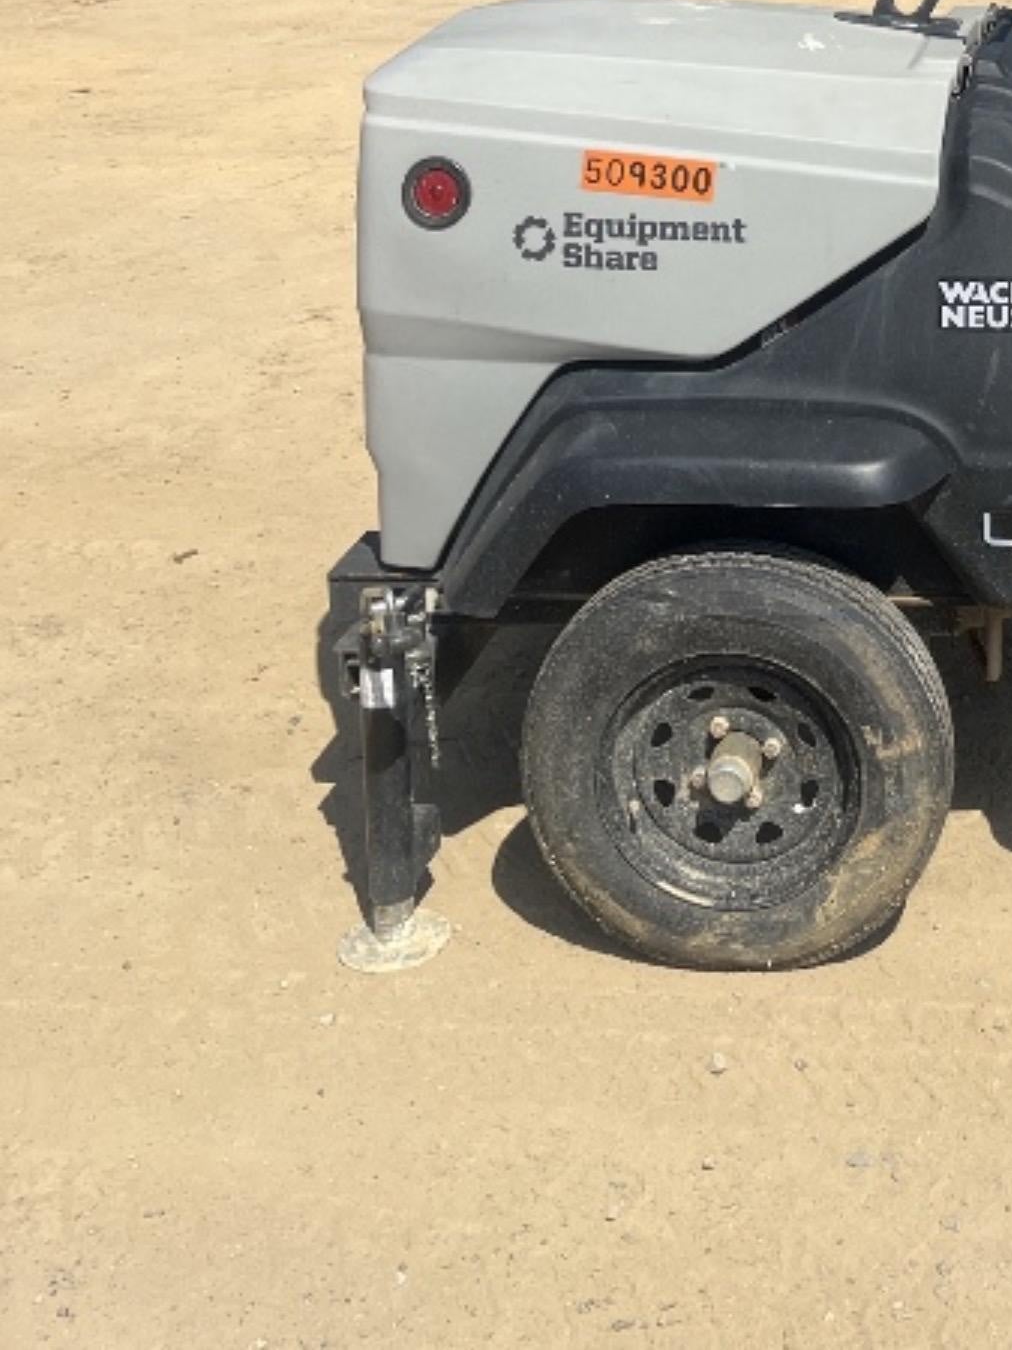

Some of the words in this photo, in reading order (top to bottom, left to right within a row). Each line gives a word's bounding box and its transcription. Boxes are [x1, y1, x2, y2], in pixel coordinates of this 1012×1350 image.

[585, 158, 713, 196] 509300
[563, 212, 747, 246] Equipment
[563, 242, 658, 271] Share
